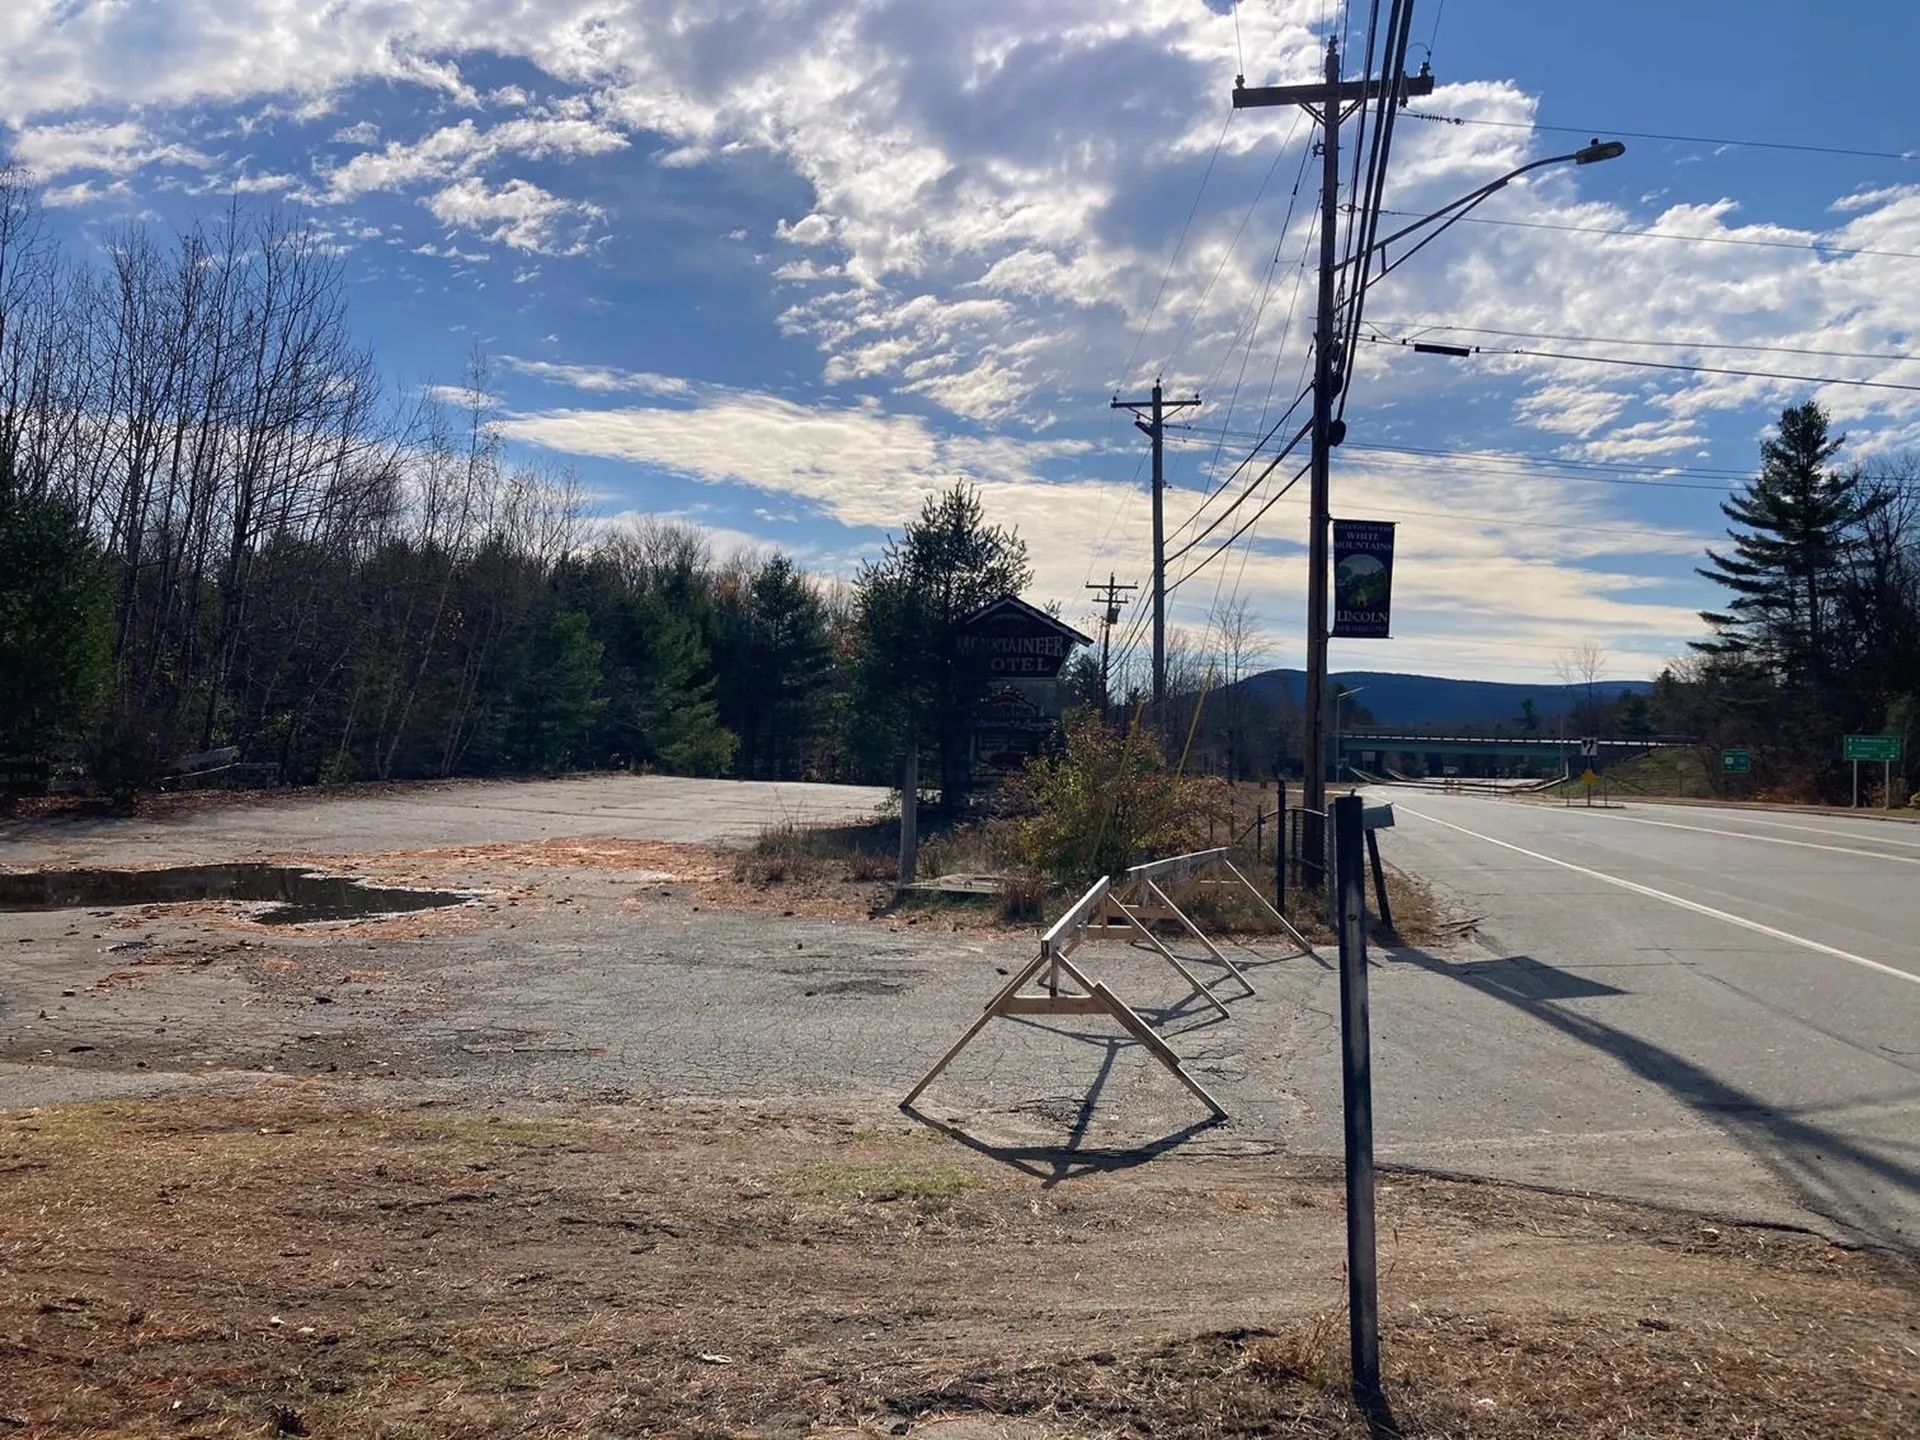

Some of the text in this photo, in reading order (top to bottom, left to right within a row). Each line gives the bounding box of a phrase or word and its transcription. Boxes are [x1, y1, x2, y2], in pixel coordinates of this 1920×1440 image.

[1346, 531, 1380, 540] WHITE
[1335, 540, 1391, 551] MOUNTAINS
[1337, 610, 1388, 623] LINCOLN
[986, 657, 1051, 671] OTEL
